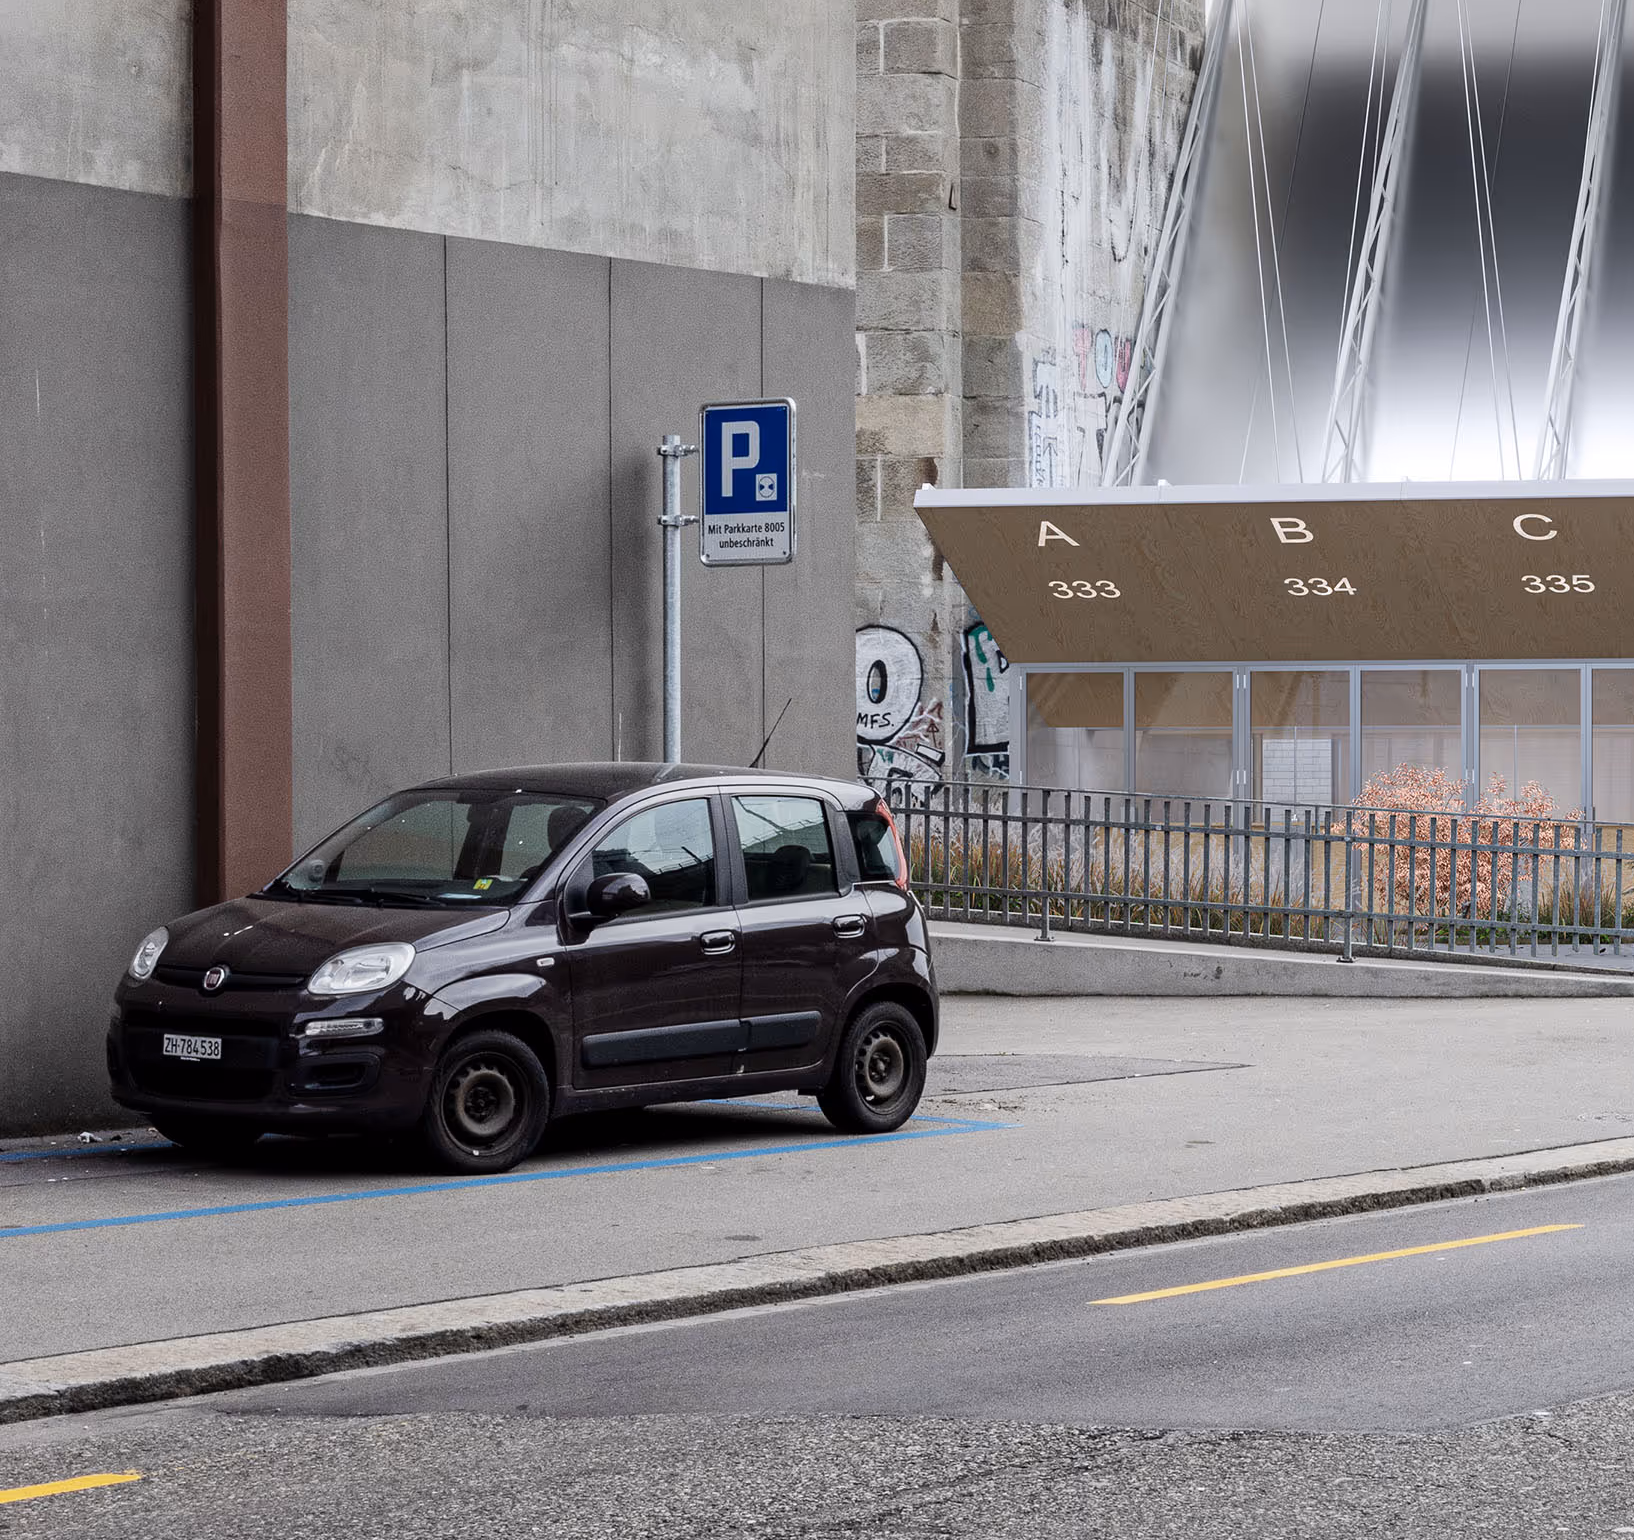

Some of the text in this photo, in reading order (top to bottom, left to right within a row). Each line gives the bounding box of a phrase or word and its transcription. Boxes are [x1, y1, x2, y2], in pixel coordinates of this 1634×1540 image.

[721, 420, 761, 498] P
[708, 521, 785, 535] Mit Parkkarte 8005
[1038, 520, 1080, 547] A
[1270, 517, 1314, 544] B
[1513, 513, 1558, 541] C
[719, 537, 774, 549] unbeschränkt
[1048, 580, 1121, 599] 333
[1284, 577, 1357, 596] 334
[1521, 574, 1596, 594] 335
